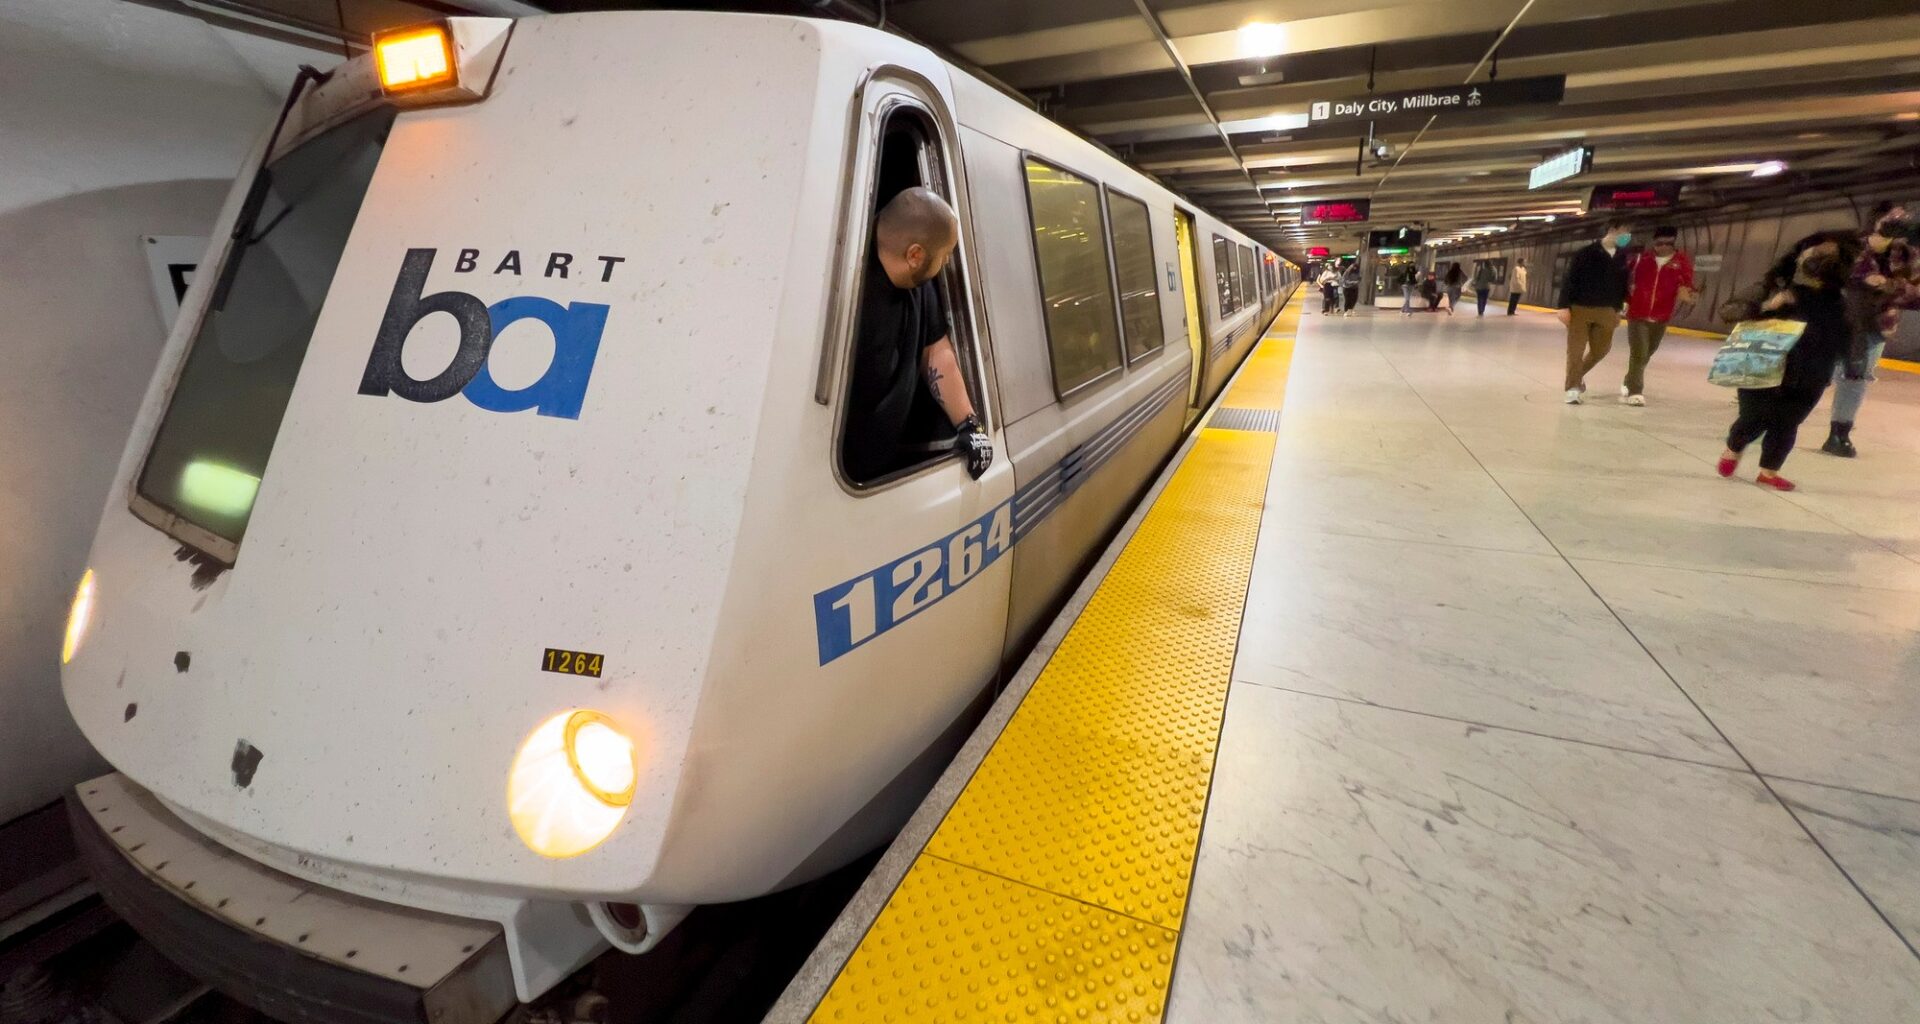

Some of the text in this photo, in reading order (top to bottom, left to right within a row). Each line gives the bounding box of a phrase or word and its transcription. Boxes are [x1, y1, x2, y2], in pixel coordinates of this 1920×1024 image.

[1335, 103, 1364, 117] Daly
[1368, 100, 1398, 113] City,
[1403, 93, 1460, 109] Millbrae
[454, 248, 626, 282] BART
[357, 247, 611, 421] ba
[832, 501, 1013, 646] 1264
[547, 650, 601, 676] 1264
